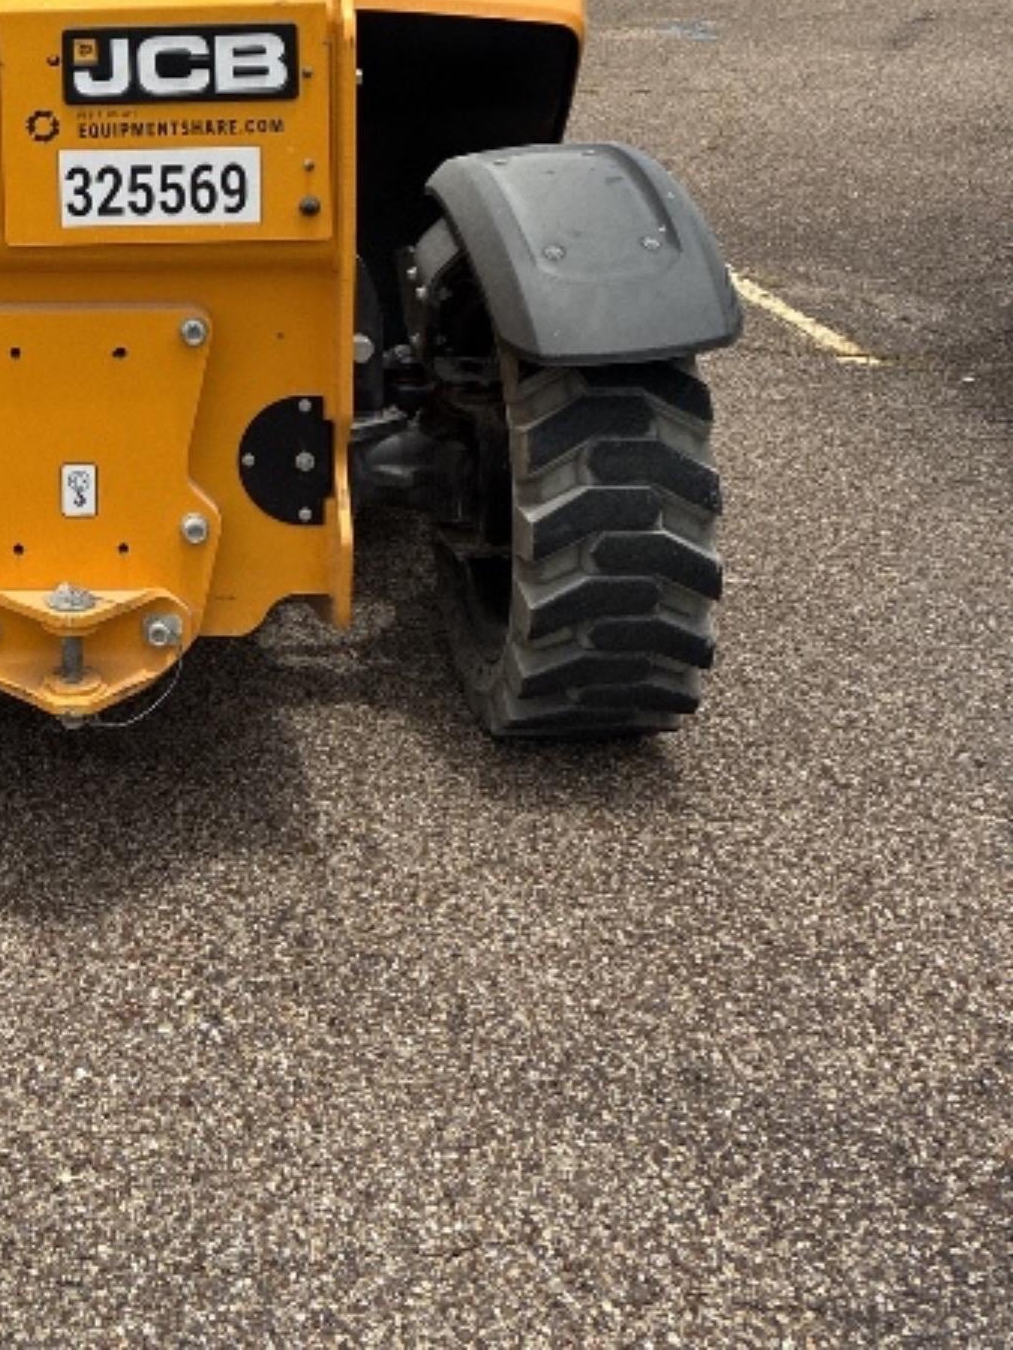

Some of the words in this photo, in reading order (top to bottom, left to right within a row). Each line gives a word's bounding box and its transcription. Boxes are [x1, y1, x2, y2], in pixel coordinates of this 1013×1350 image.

[73, 33, 288, 96] JCB
[78, 119, 285, 139] EQUIPMENTSHARE.COM
[64, 161, 248, 217] 325569
